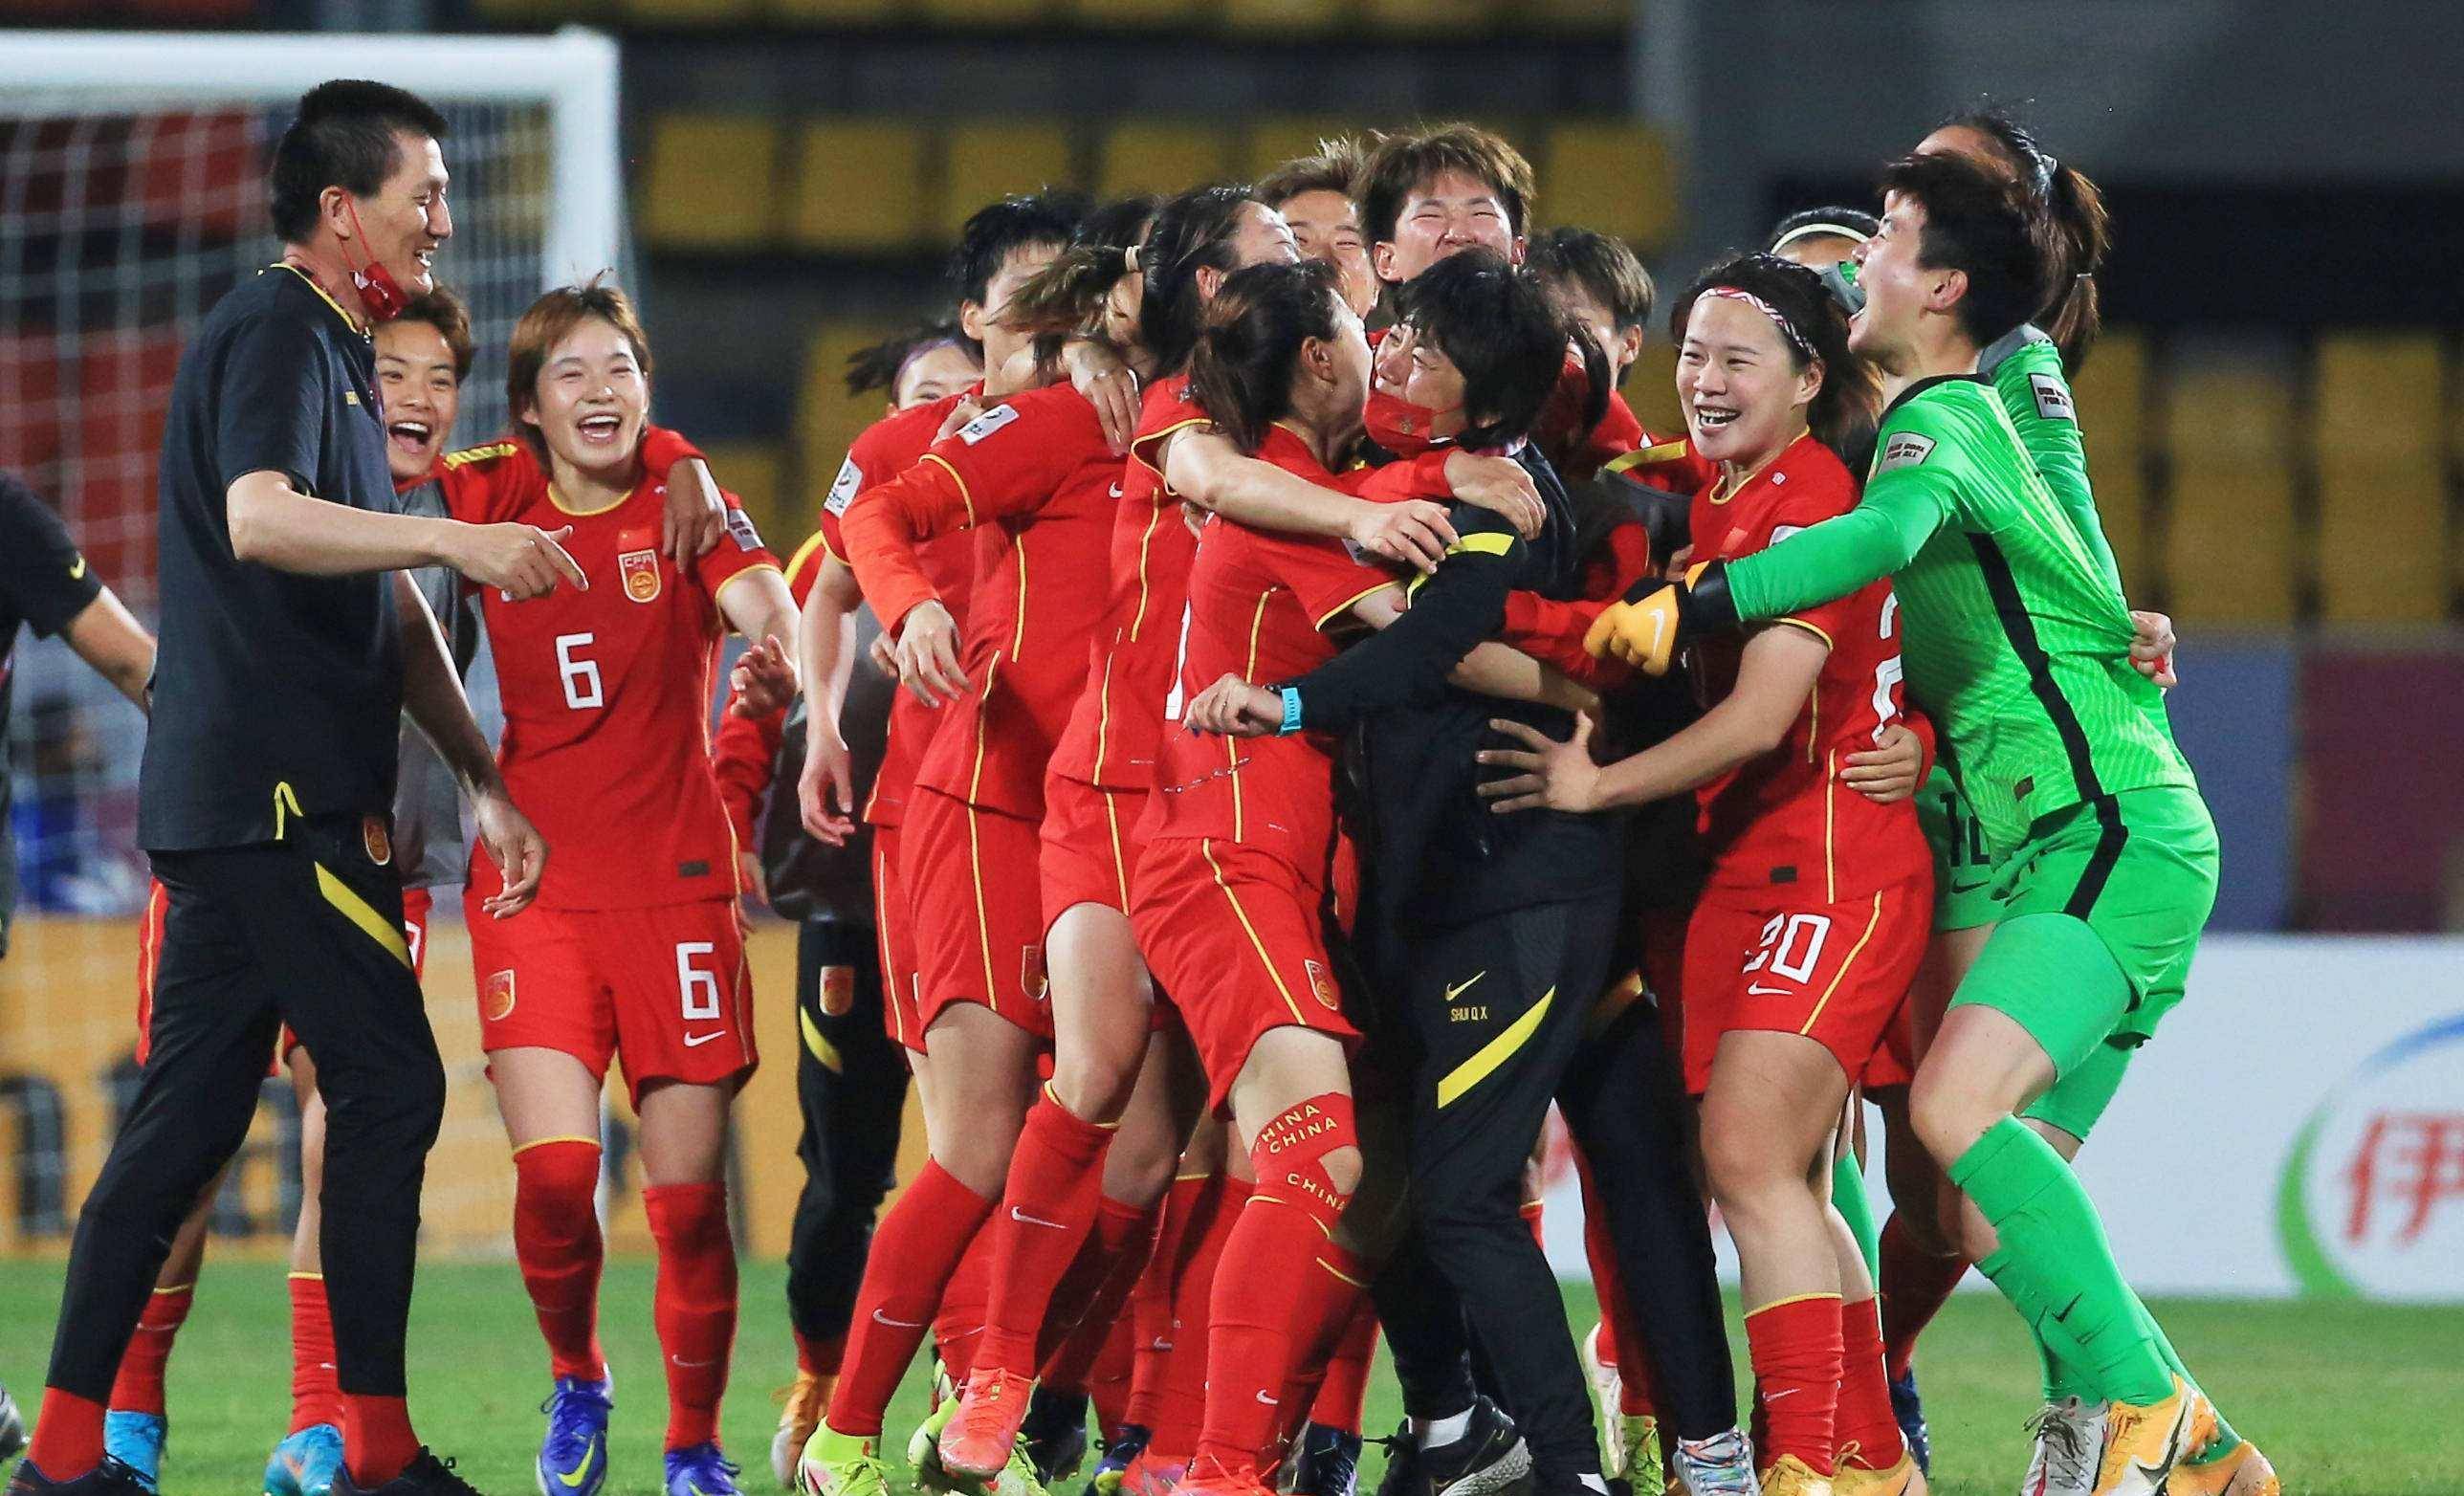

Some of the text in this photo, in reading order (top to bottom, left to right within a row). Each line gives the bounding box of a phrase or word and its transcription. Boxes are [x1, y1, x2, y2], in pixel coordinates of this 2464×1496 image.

[556, 632, 604, 709] 6
[1742, 913, 1831, 984] 20
[675, 941, 721, 1021] 6
[1480, 1005, 1488, 1020] X
[1255, 1104, 1320, 1152] HINA
[1269, 1116, 1337, 1154] CHINA
